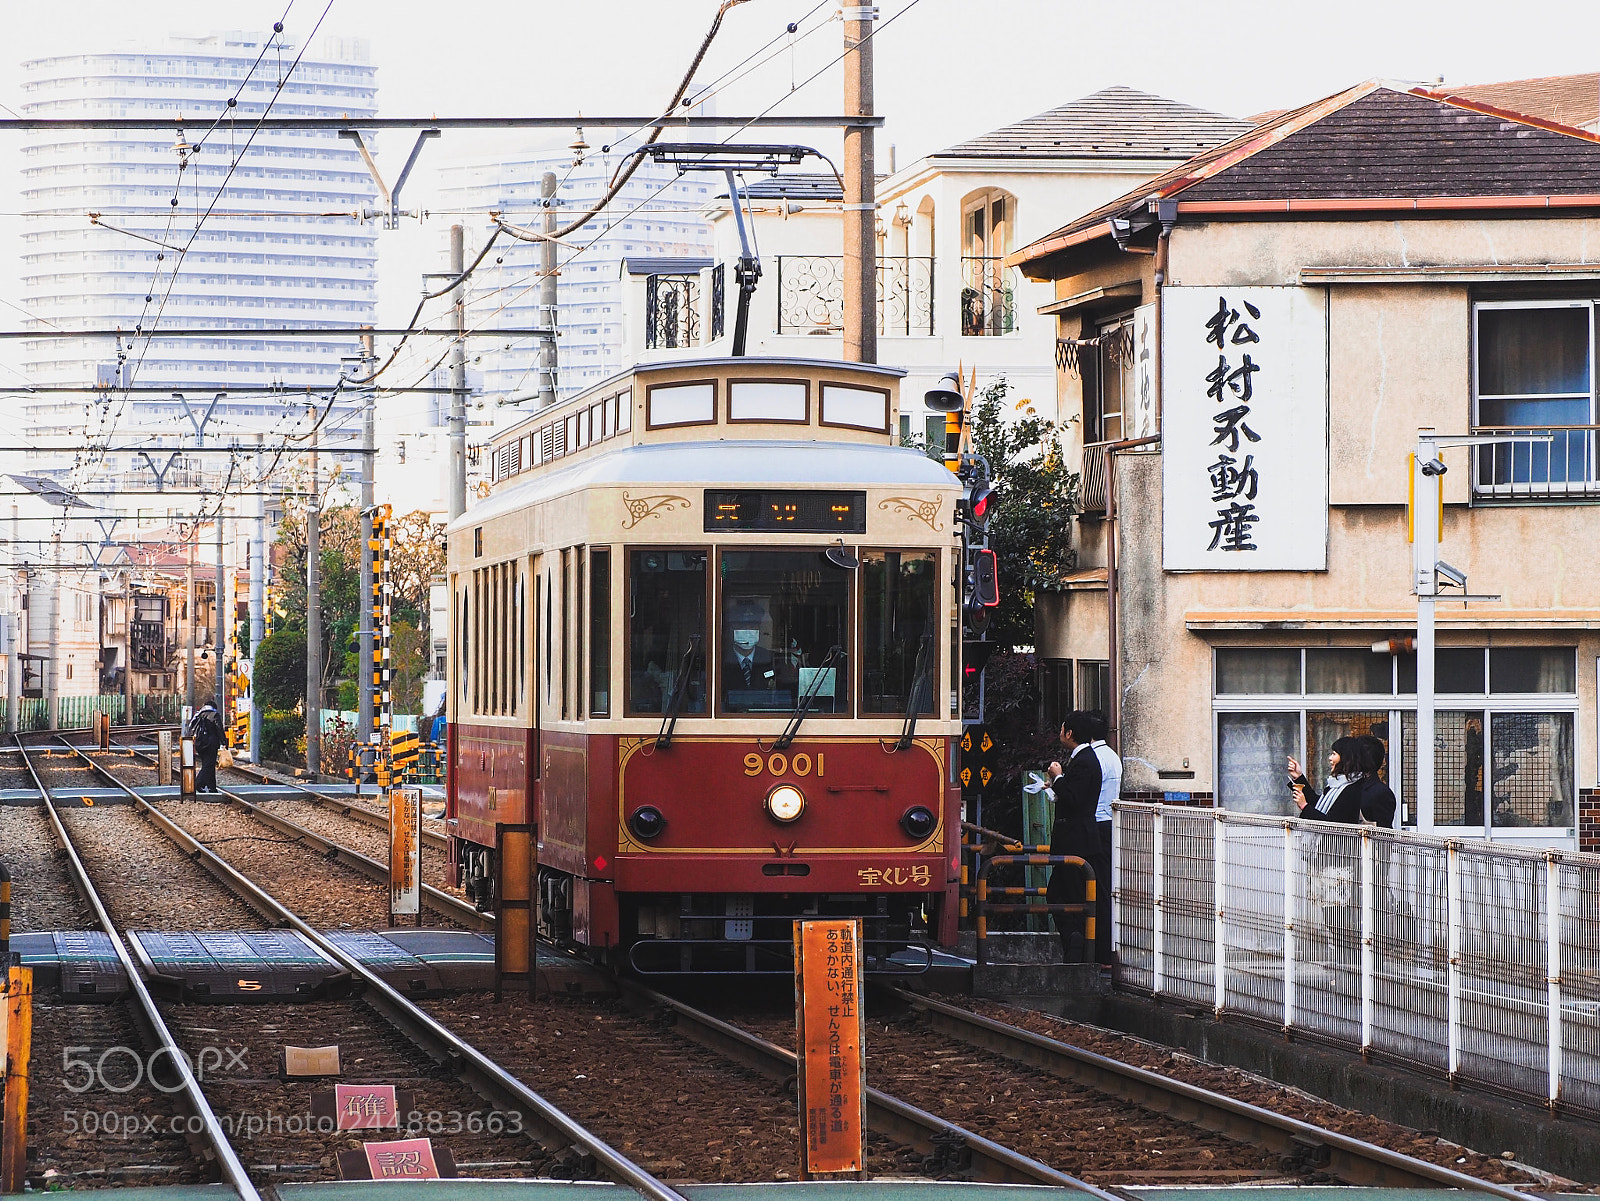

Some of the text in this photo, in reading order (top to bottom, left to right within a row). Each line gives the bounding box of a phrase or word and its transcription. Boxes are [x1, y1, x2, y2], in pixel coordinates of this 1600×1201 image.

[1205, 296, 1262, 551] 松村不動産
[743, 752, 825, 777] 9001
[857, 865, 932, 887] 宝くじ号
[840, 928, 854, 1018] 軌道内通行禁止
[344, 1093, 389, 1117] 確
[375, 1151, 429, 1176] 認
